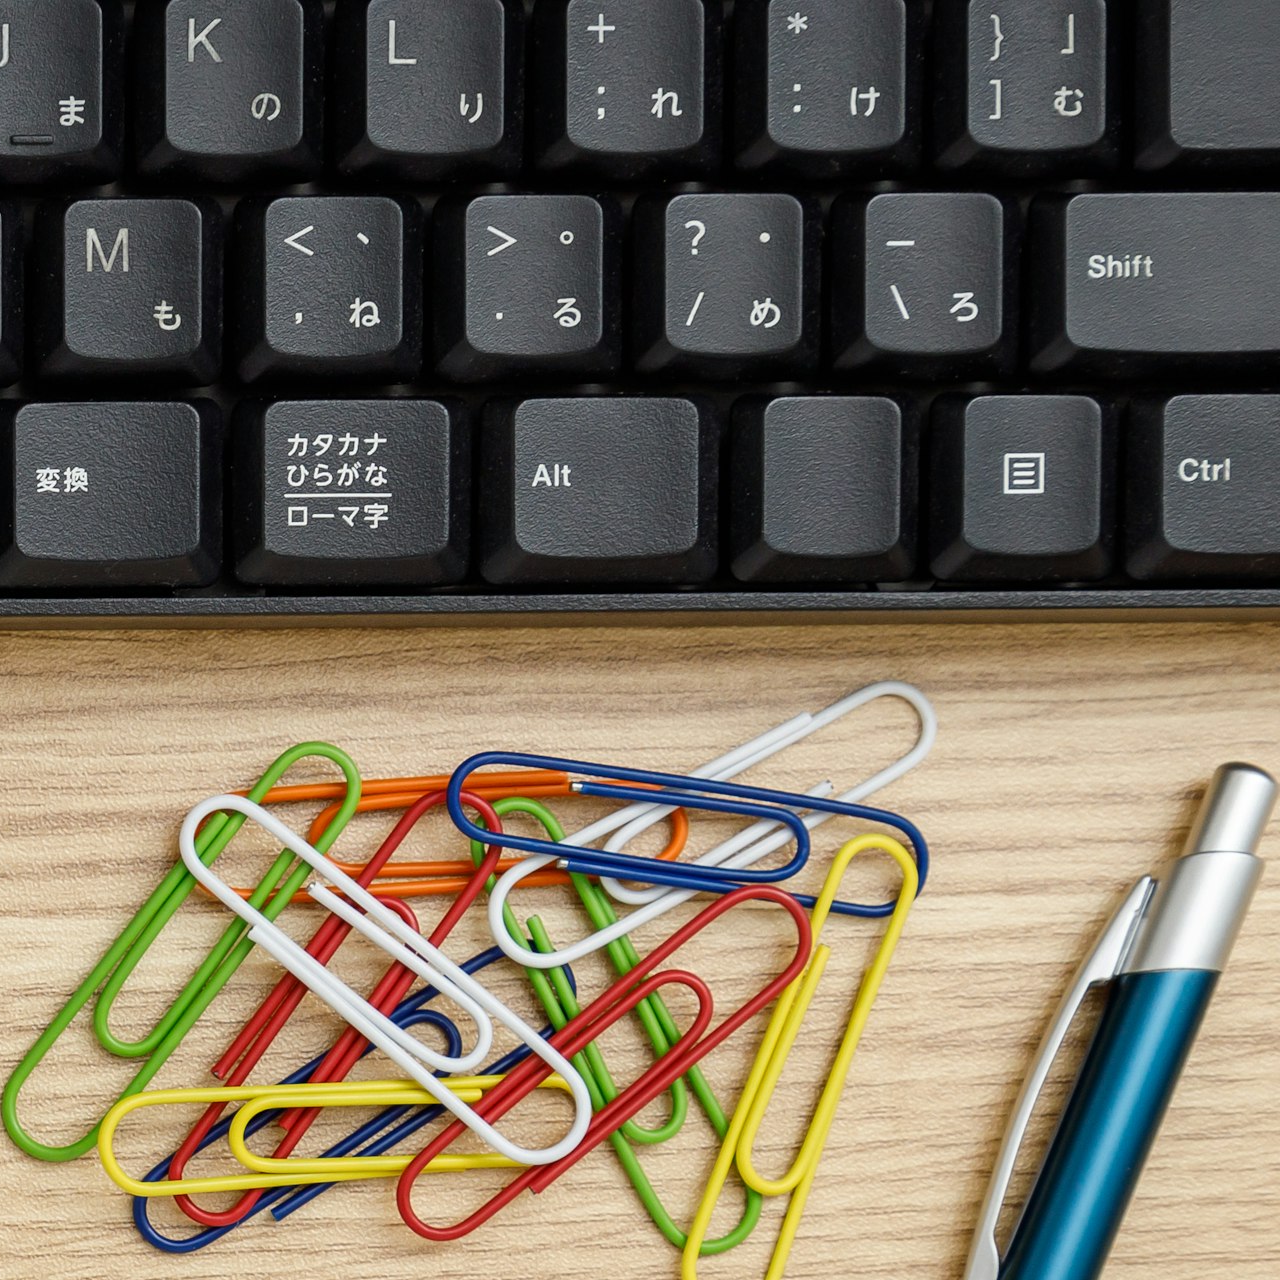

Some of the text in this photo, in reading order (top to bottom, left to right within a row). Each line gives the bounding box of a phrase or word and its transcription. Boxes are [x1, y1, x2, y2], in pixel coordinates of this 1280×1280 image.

[188, 18, 222, 63] K
[388, 19, 417, 65] L
[586, 13, 616, 44] +
[989, 14, 1004, 61] }
[58, 95, 86, 127] ま
[251, 92, 281, 121] の
[459, 92, 483, 124] り
[597, 86, 683, 120] ; れ
[793, 83, 881, 117] : け
[988, 79, 1084, 120] ] む
[86, 227, 129, 273] M
[283, 225, 314, 256] <
[486, 225, 518, 257] >
[684, 220, 706, 256] ?
[1087, 254, 1154, 279] Shift
[153, 300, 182, 331] も
[348, 297, 381, 328] ね
[552, 297, 582, 328] る
[685, 291, 781, 329] / め
[949, 291, 979, 322] ろ
[287, 432, 388, 457] カタカナ
[35, 466, 89, 493] 変換
[286, 461, 388, 487] ひらがな
[531, 463, 572, 487] Alt
[1178, 457, 1231, 482] Ctrl
[287, 502, 389, 529] ローマ字
